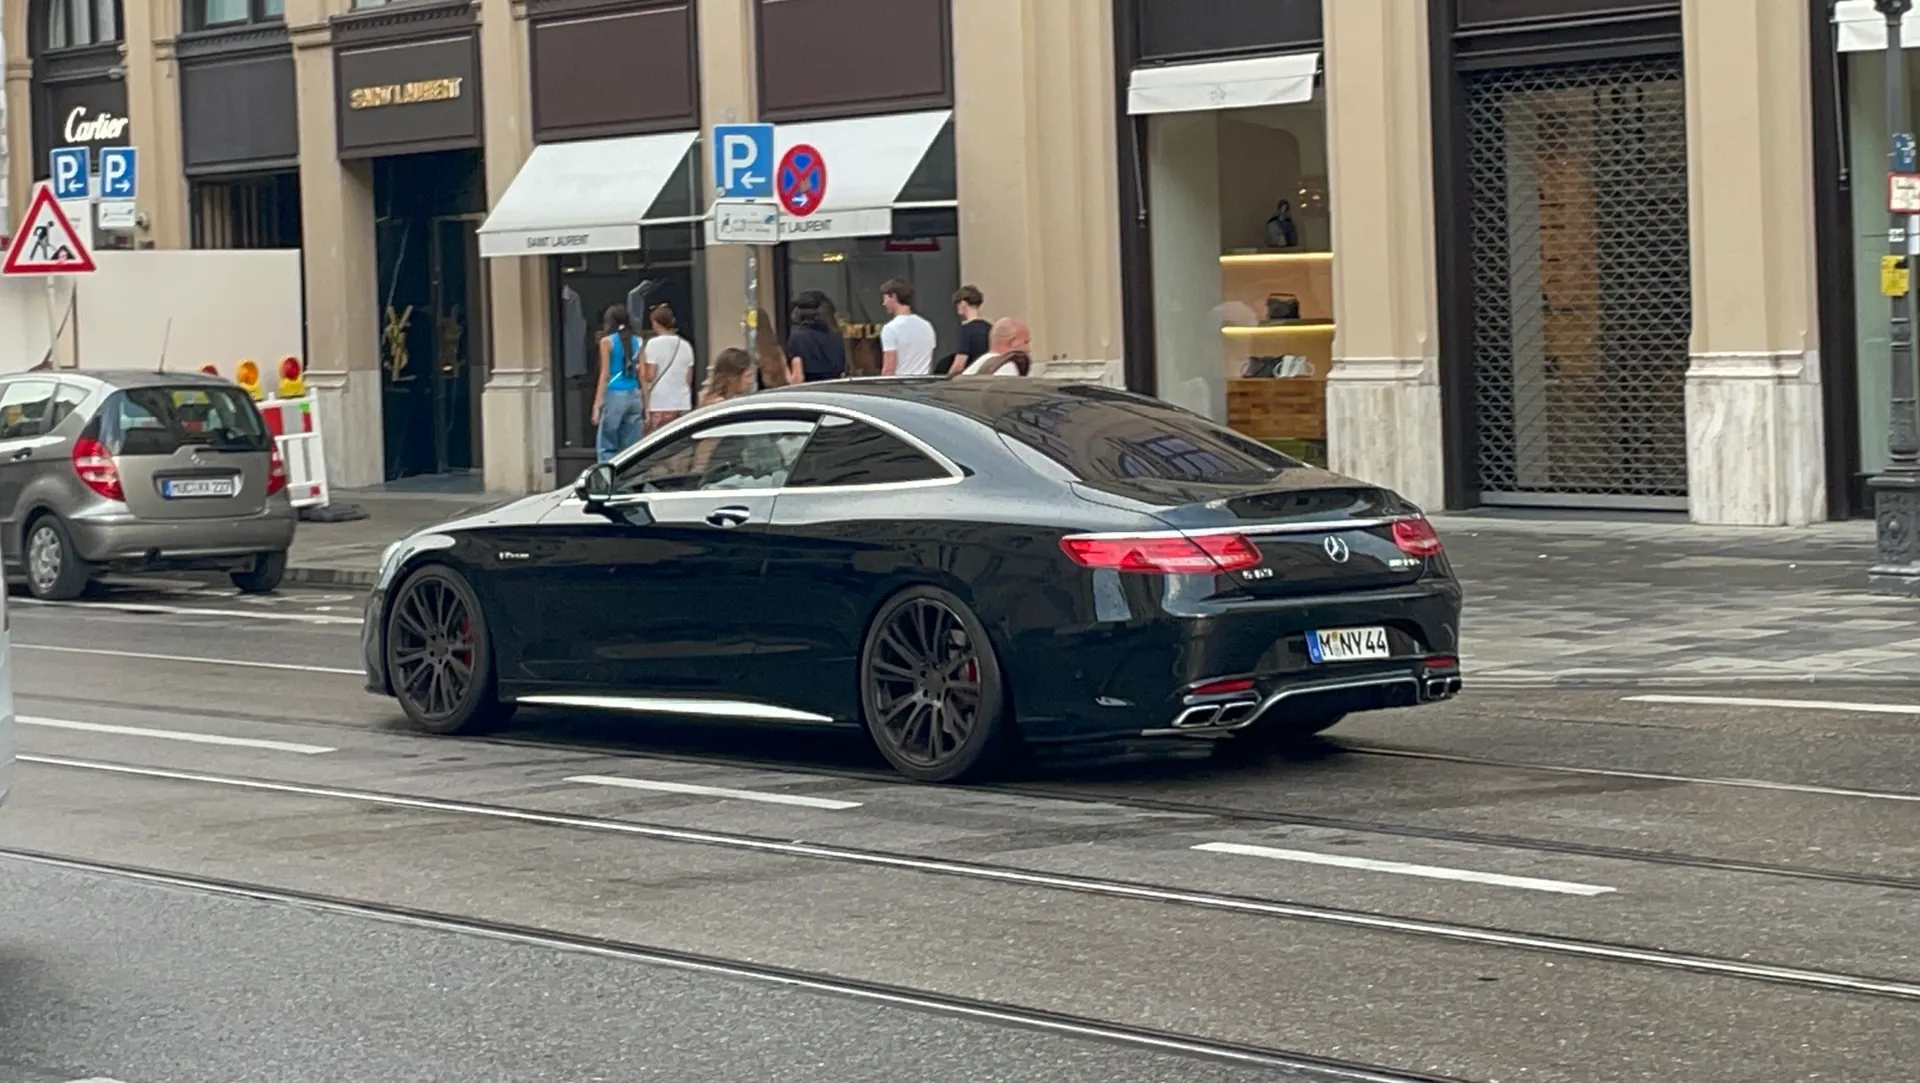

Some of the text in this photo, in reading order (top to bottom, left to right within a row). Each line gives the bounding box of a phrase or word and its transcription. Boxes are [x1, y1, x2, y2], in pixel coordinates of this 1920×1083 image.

[64, 106, 129, 143] Cartier
[57, 155, 78, 194] P
[105, 154, 126, 193] P
[723, 134, 758, 190] P
